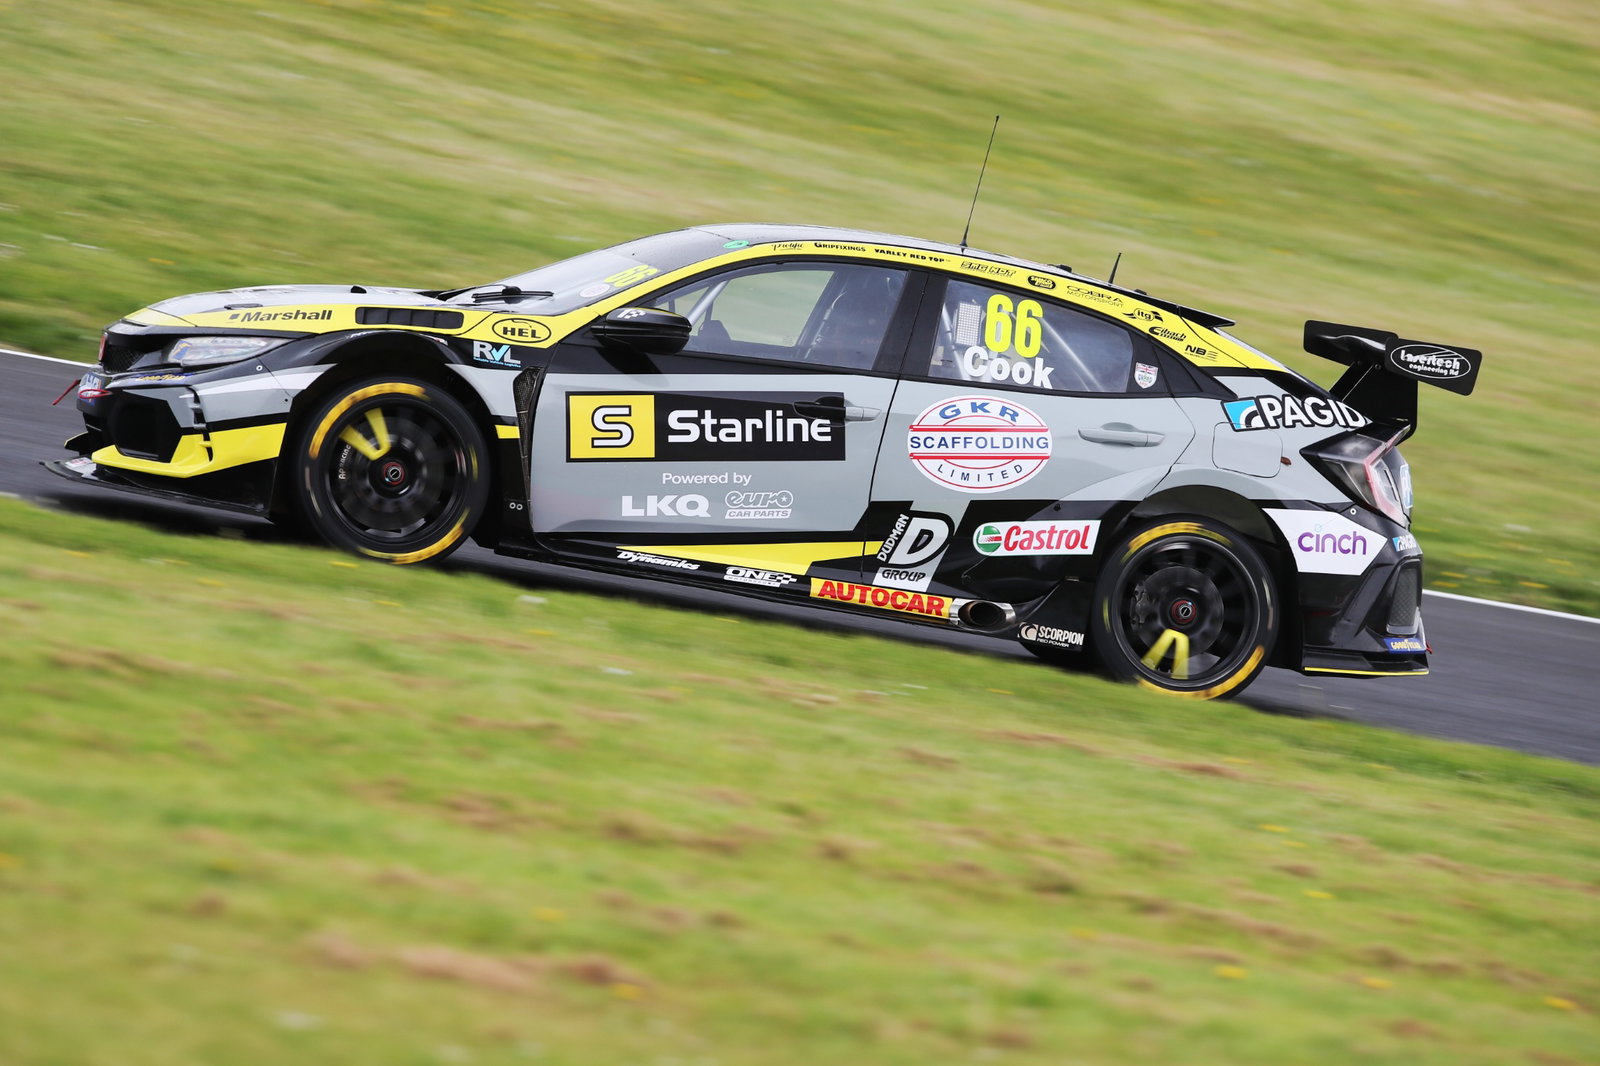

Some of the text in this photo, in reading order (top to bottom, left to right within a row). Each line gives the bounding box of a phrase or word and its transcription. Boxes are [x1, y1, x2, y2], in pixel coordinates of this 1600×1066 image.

[875, 248, 907, 258] VARLEY
[1067, 285, 1123, 303] COBRA
[1067, 290, 1124, 308] MOTORSPORT
[241, 309, 333, 322] Marshall
[502, 326, 541, 339] HEL
[984, 294, 1043, 358] 66
[1148, 326, 1187, 340] Eibach
[963, 345, 1055, 389] Cook
[1409, 363, 1448, 375] engineering
[939, 402, 1019, 422] GKR
[1262, 396, 1368, 428] PAGID
[667, 409, 832, 443] Starline
[910, 436, 1049, 449] SCAFFOLDING
[662, 472, 752, 486] Powered by
[937, 464, 1023, 482] LIMITED
[622, 494, 712, 517] LKQ
[725, 490, 793, 508] euro
[728, 509, 789, 518] CAR PARTS
[877, 513, 909, 562] DUDMAN
[1003, 525, 1091, 551] Castrol
[1298, 525, 1367, 555] cinch
[617, 550, 700, 571] Dynamics
[725, 567, 777, 583] ONE
[881, 569, 926, 582] GROUP
[818, 580, 944, 617] AUTOCAR
[1038, 625, 1084, 645] SCORPION
